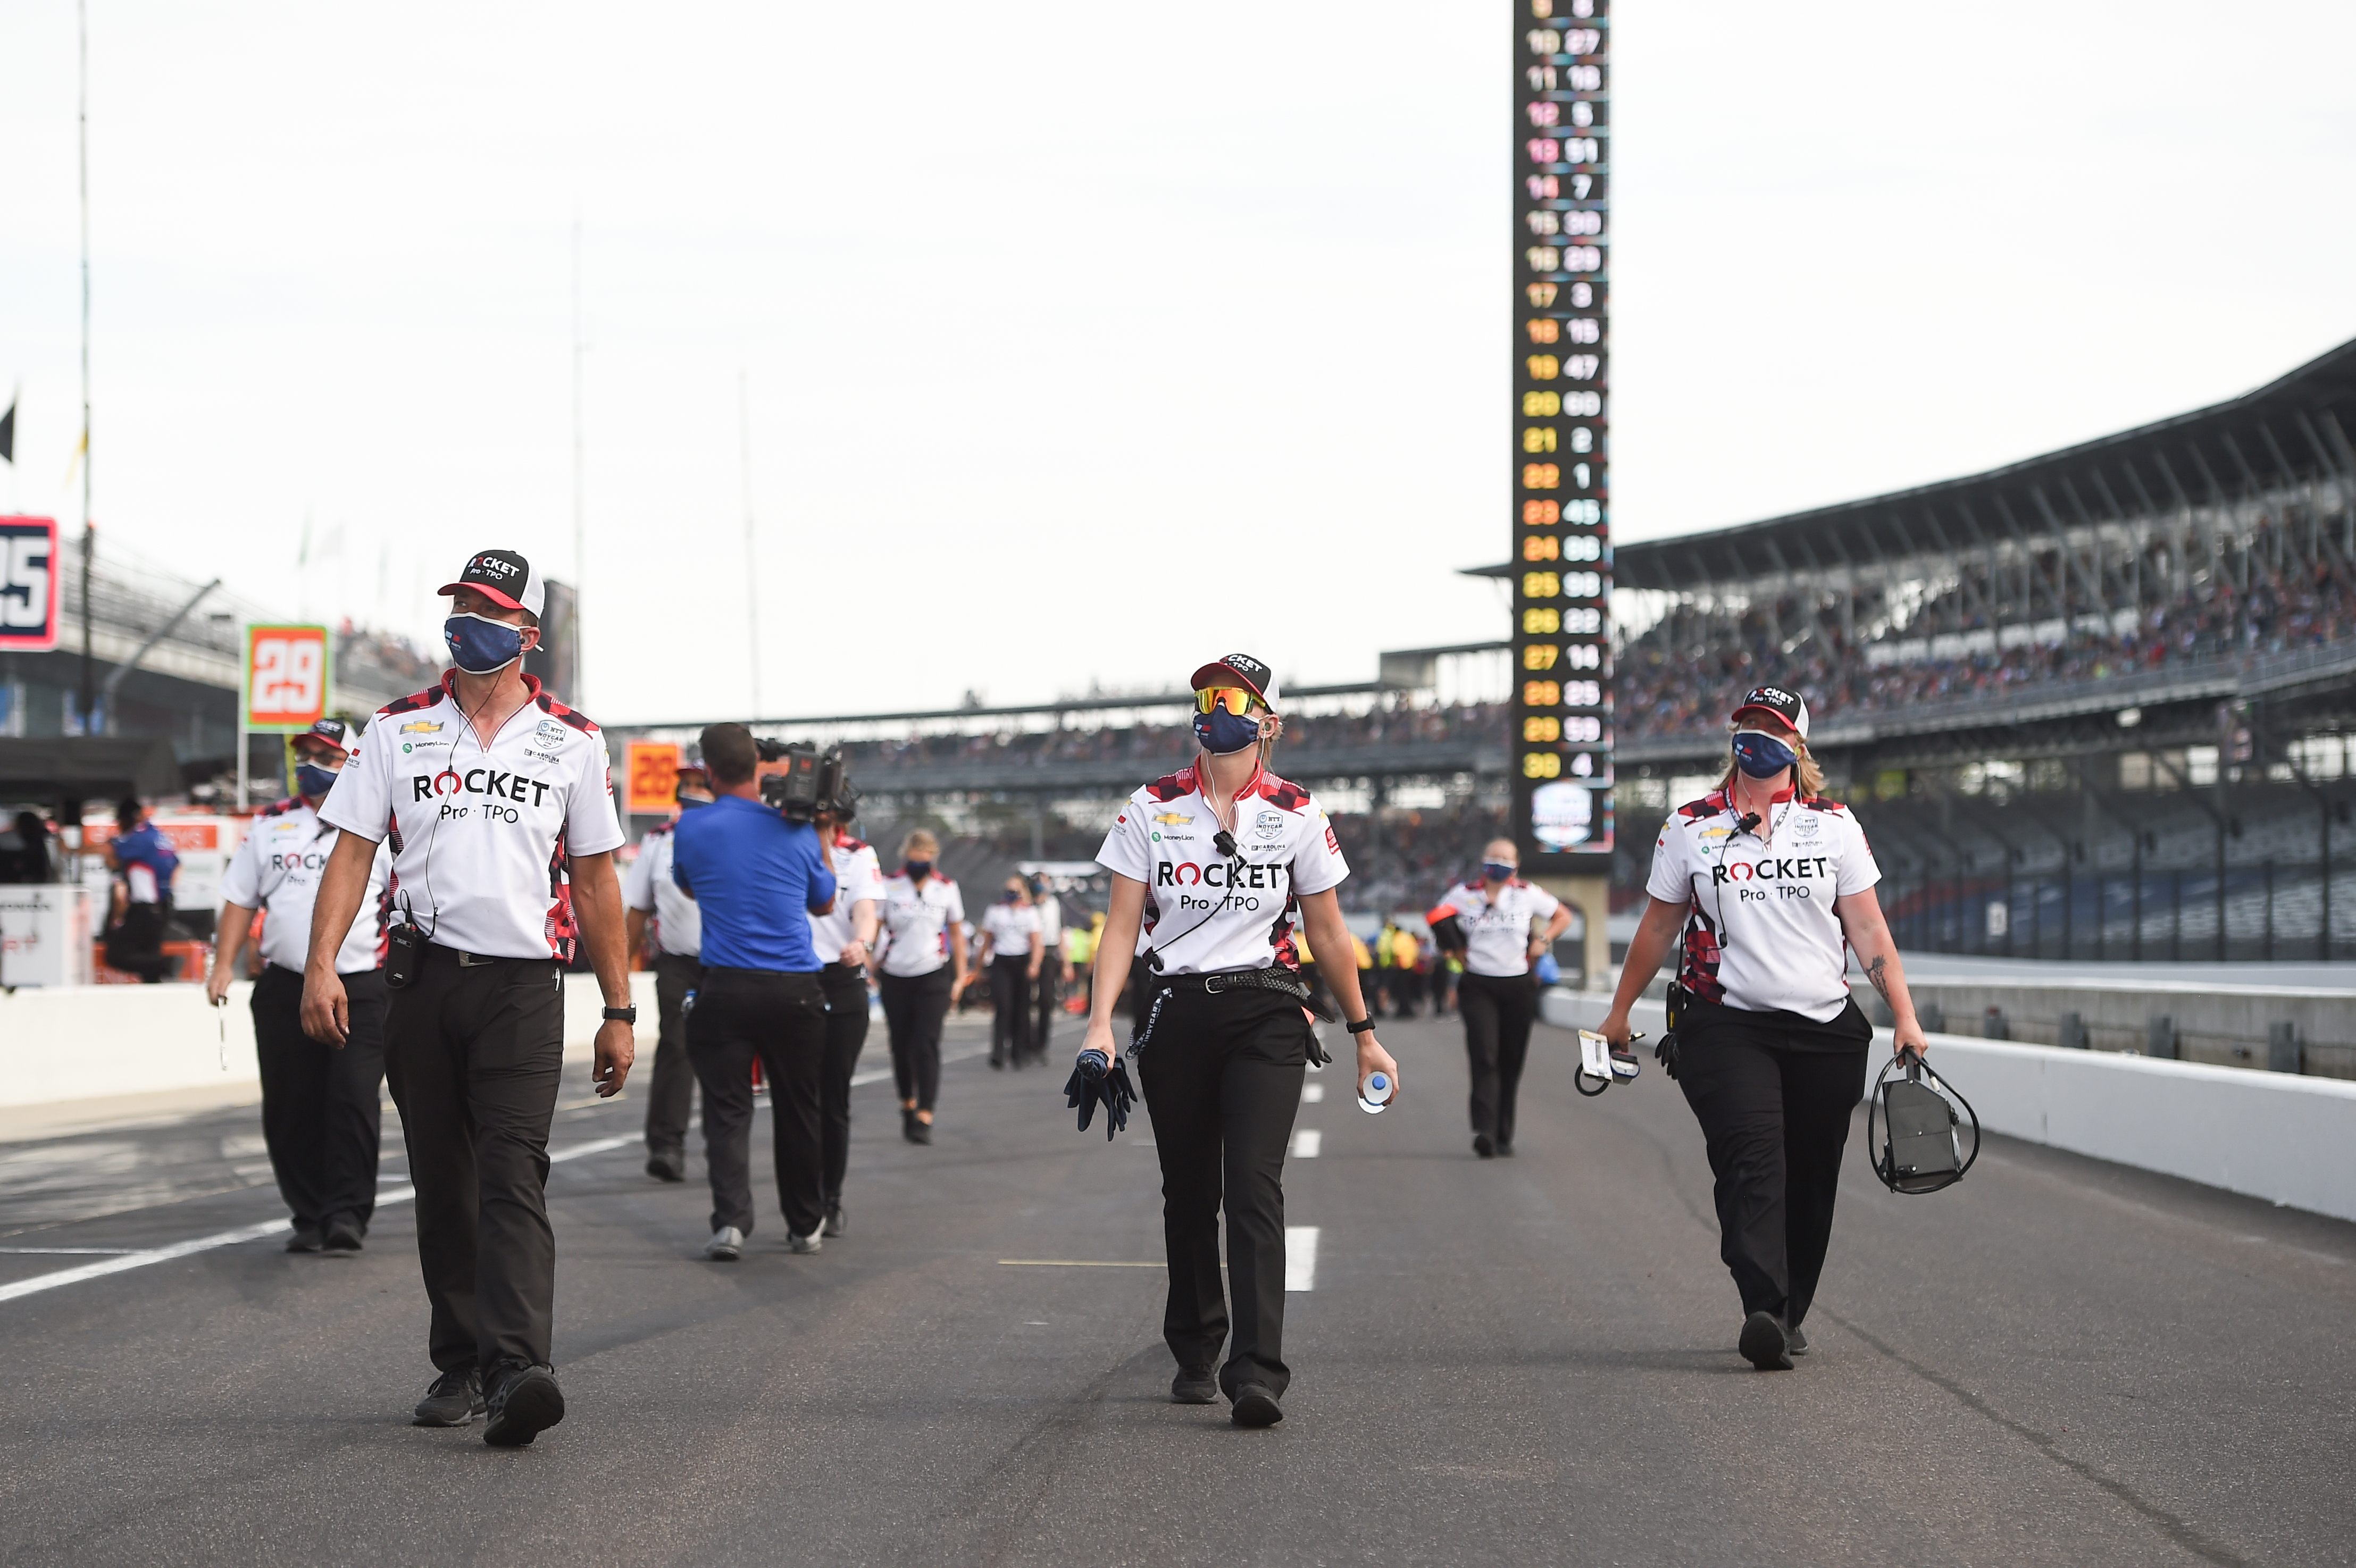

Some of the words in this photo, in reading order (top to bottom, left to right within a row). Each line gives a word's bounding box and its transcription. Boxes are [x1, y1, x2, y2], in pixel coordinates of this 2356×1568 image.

[1527, 29, 1559, 54] 10
[1565, 29, 1600, 54] 27
[1527, 65, 1557, 91] 11
[1527, 102, 1559, 127] 12
[1573, 174, 1592, 199] 7
[1526, 282, 1558, 308] 17
[1564, 355, 1599, 380] 47
[1524, 427, 1557, 452] 21
[1572, 427, 1592, 452] 2
[1523, 463, 1559, 489] 22
[1574, 463, 1590, 489] 1
[1563, 499, 1600, 525] 45
[468, 557, 520, 577] ROCKET
[486, 569, 503, 580] TPO
[0, 535, 49, 627] 5
[1564, 608, 1600, 633] 22
[1233, 662, 1249, 672] TPO
[1524, 644, 1558, 669] 27
[253, 639, 324, 714] 29
[1750, 687, 1794, 705] ROCKET
[1768, 697, 1782, 706] TPO
[536, 731, 564, 742] INDYCAR
[532, 751, 559, 763] CAROLINA
[1523, 753, 1560, 778] 30
[1571, 753, 1592, 778] 4
[413, 769, 550, 807] ROCKET
[441, 805, 467, 819] Pro
[482, 804, 518, 823] TPO
[1158, 861, 1282, 888] ROCKET
[1712, 857, 1826, 886] ROCKET
[1181, 895, 1209, 909] Pro
[1223, 896, 1259, 911] TPO
[1740, 889, 1765, 902] Pro
[1776, 886, 1810, 899] TPO
[1144, 1007, 1158, 1042] INDYCAR
